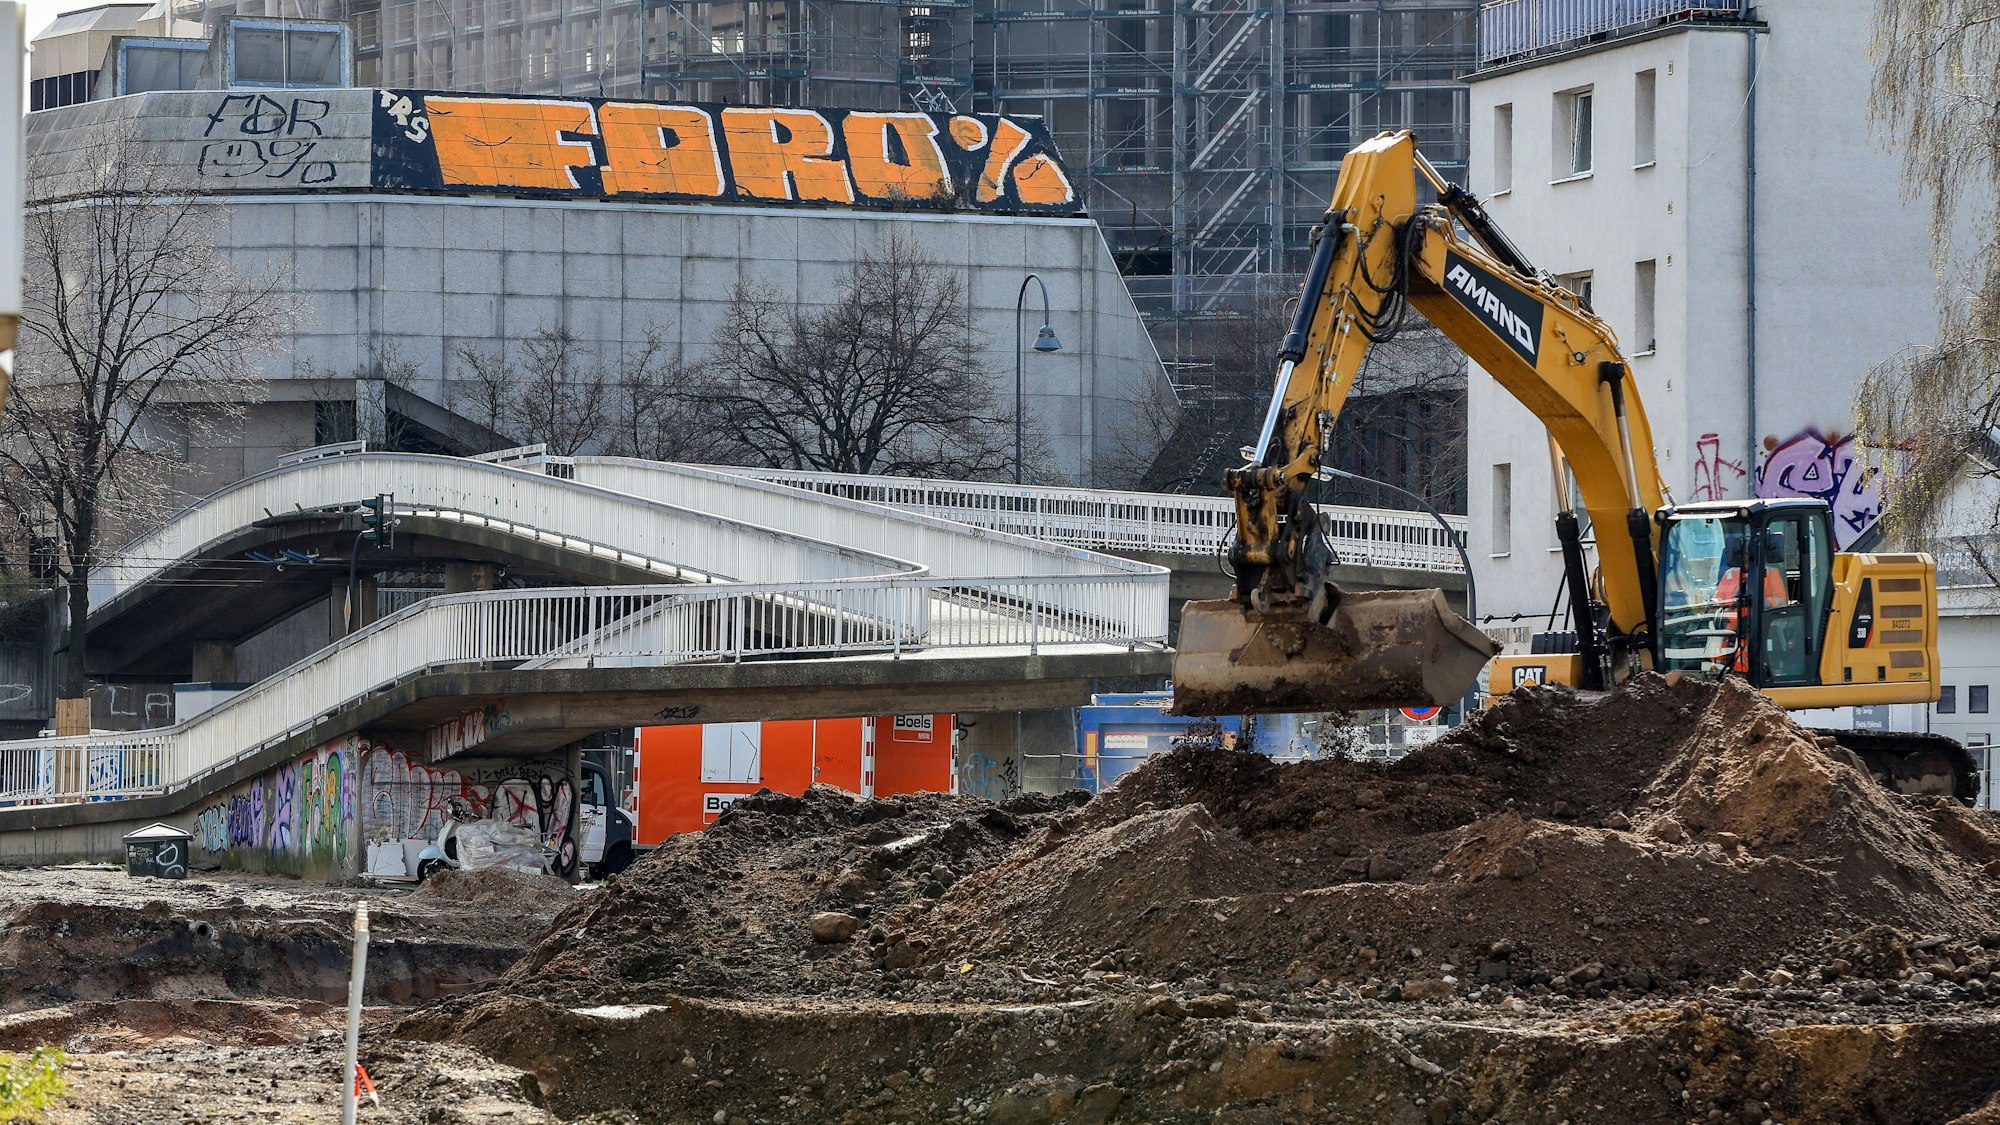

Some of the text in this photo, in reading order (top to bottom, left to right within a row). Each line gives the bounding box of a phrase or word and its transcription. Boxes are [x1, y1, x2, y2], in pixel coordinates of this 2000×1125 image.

[1446, 263, 1536, 355] AMAND
[1514, 667, 1544, 687] CAT
[896, 714, 931, 728] Boels
